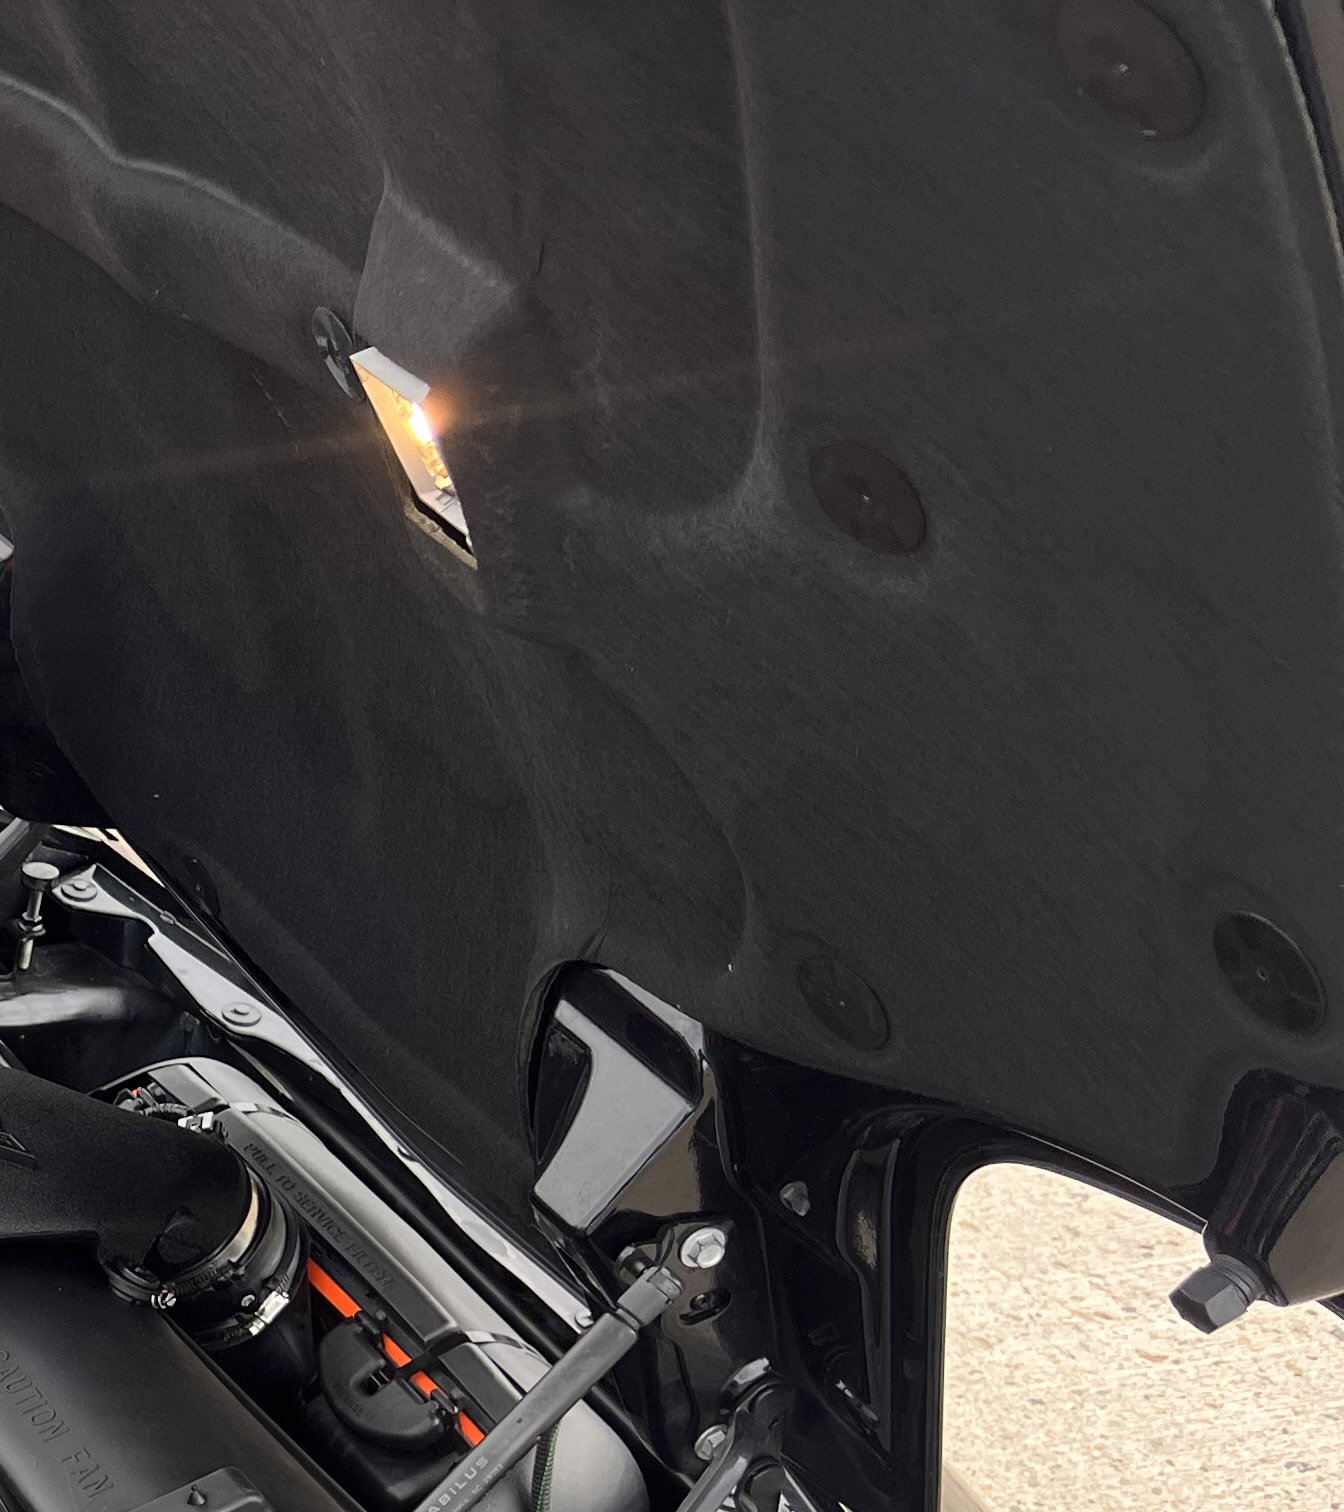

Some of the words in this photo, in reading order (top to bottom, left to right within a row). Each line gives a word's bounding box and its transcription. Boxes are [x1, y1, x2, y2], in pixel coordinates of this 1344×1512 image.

[242, 1139, 280, 1177] PULL
[275, 1171, 298, 1194] TO
[292, 1188, 349, 1245] SERVICE
[60, 1446, 116, 1500] FAN
